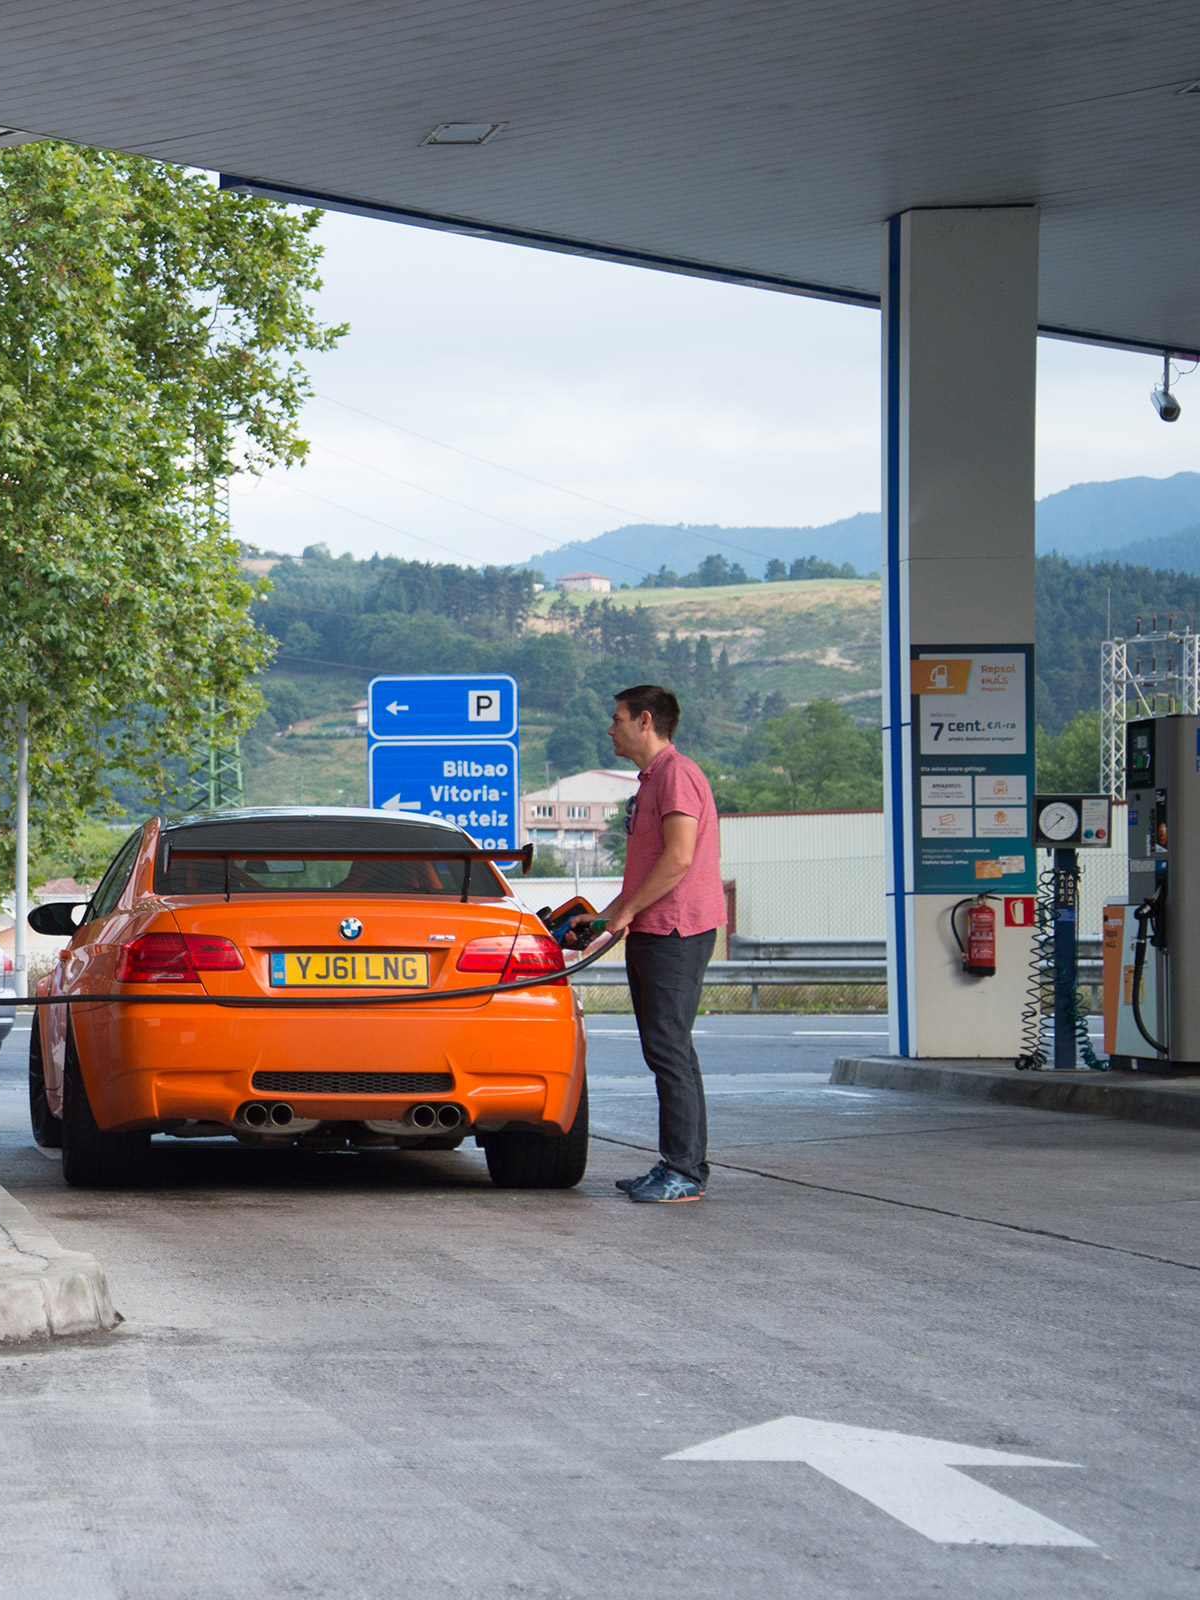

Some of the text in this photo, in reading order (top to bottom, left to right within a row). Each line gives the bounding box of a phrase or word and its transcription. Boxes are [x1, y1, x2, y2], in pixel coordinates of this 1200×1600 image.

[981, 664, 1016, 675] Repsol
[981, 675, 1009, 685] más
[476, 695, 493, 717] P
[930, 722, 945, 742] 7
[948, 720, 985, 732] cent.
[443, 760, 508, 778] Bilbao
[430, 785, 508, 802] Vitoria-
[296, 956, 418, 981] YJ61 LNG
